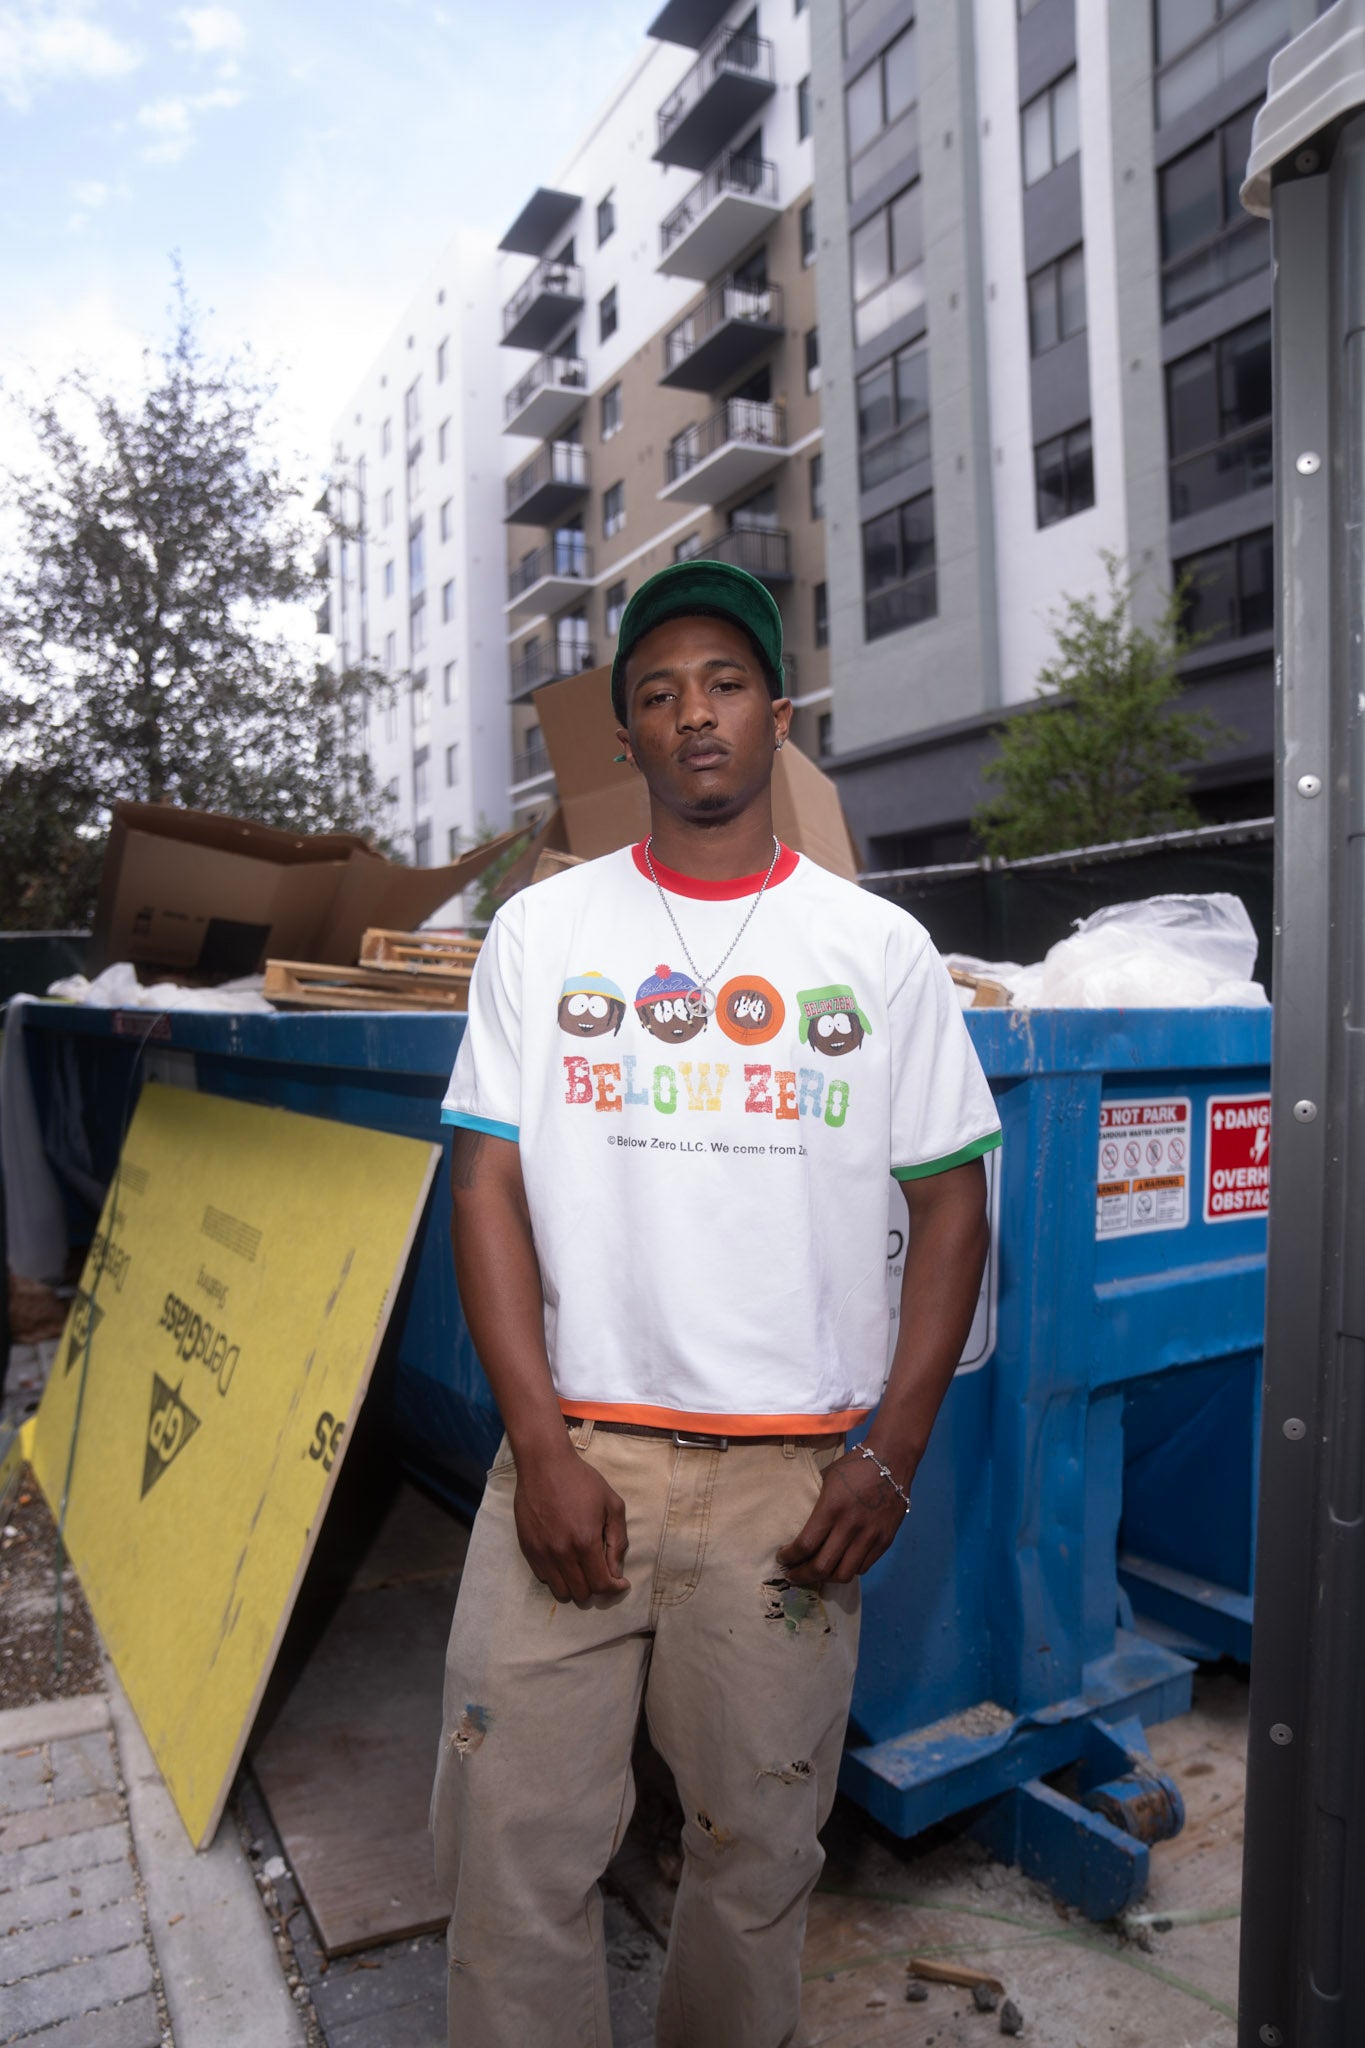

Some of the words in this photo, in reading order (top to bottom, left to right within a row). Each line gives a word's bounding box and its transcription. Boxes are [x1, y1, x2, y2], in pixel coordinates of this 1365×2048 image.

[803, 999, 833, 1017] BELOW
[833, 996, 856, 1011] ZERO
[563, 1055, 730, 1115] BELOW
[744, 1064, 850, 1128] ZERO
[1111, 1107, 1140, 1125] NOT
[1142, 1105, 1177, 1122] PARK
[1225, 1105, 1271, 1130] DANG
[1154, 1126, 1186, 1136] ACCEPTED
[650, 1138, 677, 1151] Zero
[680, 1141, 707, 1152] LLC.
[710, 1142, 730, 1153] We
[733, 1145, 766, 1155] come
[769, 1144, 797, 1155] from
[1144, 1177, 1180, 1189] WARNING
[1213, 1166, 1270, 1190] OVERH
[1212, 1188, 1269, 1212] OBSTAC
[159, 1292, 241, 1398] DensGlass
[150, 1399, 185, 1463] GP
